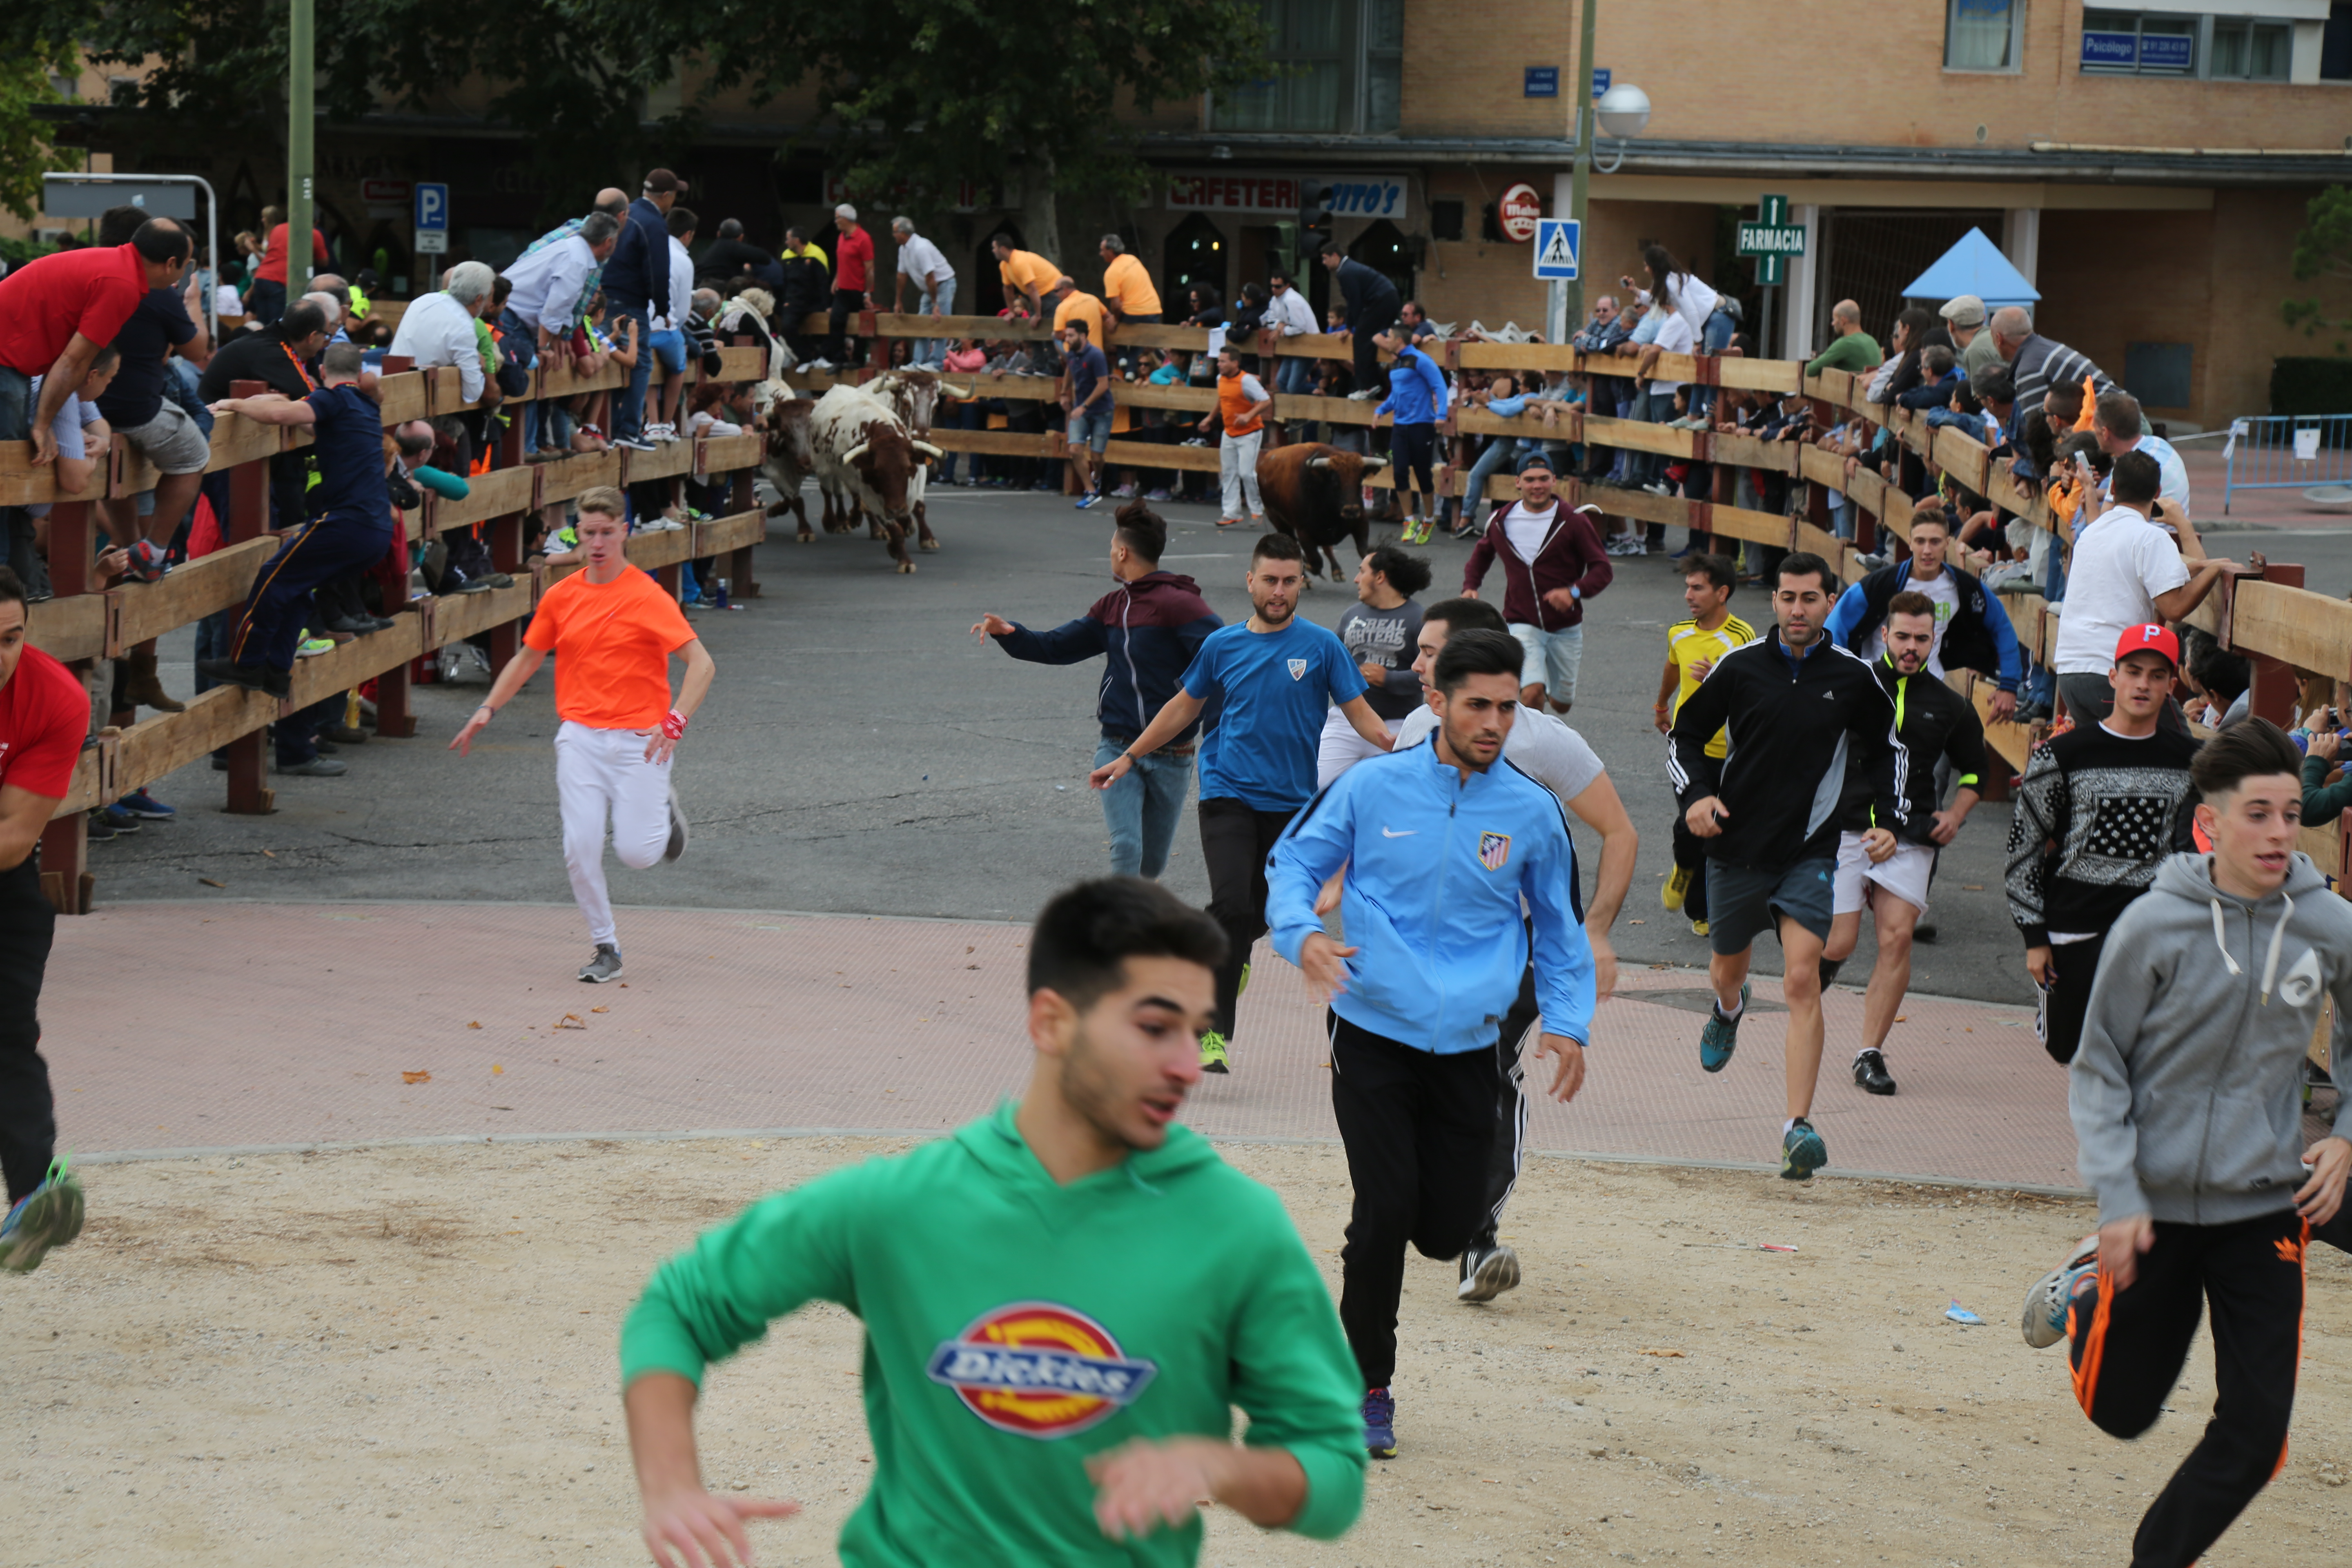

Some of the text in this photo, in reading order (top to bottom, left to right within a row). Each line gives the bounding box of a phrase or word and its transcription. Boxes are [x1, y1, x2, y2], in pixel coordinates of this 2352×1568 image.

[2086, 37, 2132, 57] Psicólogo
[421, 189, 441, 224] P
[1171, 176, 1400, 214] CAFETERI SITO'S
[1741, 228, 1804, 252] FARMACIA
[1363, 617, 1406, 633] REAL
[2143, 625, 2161, 642] P
[945, 1349, 1132, 1394] Dickies
